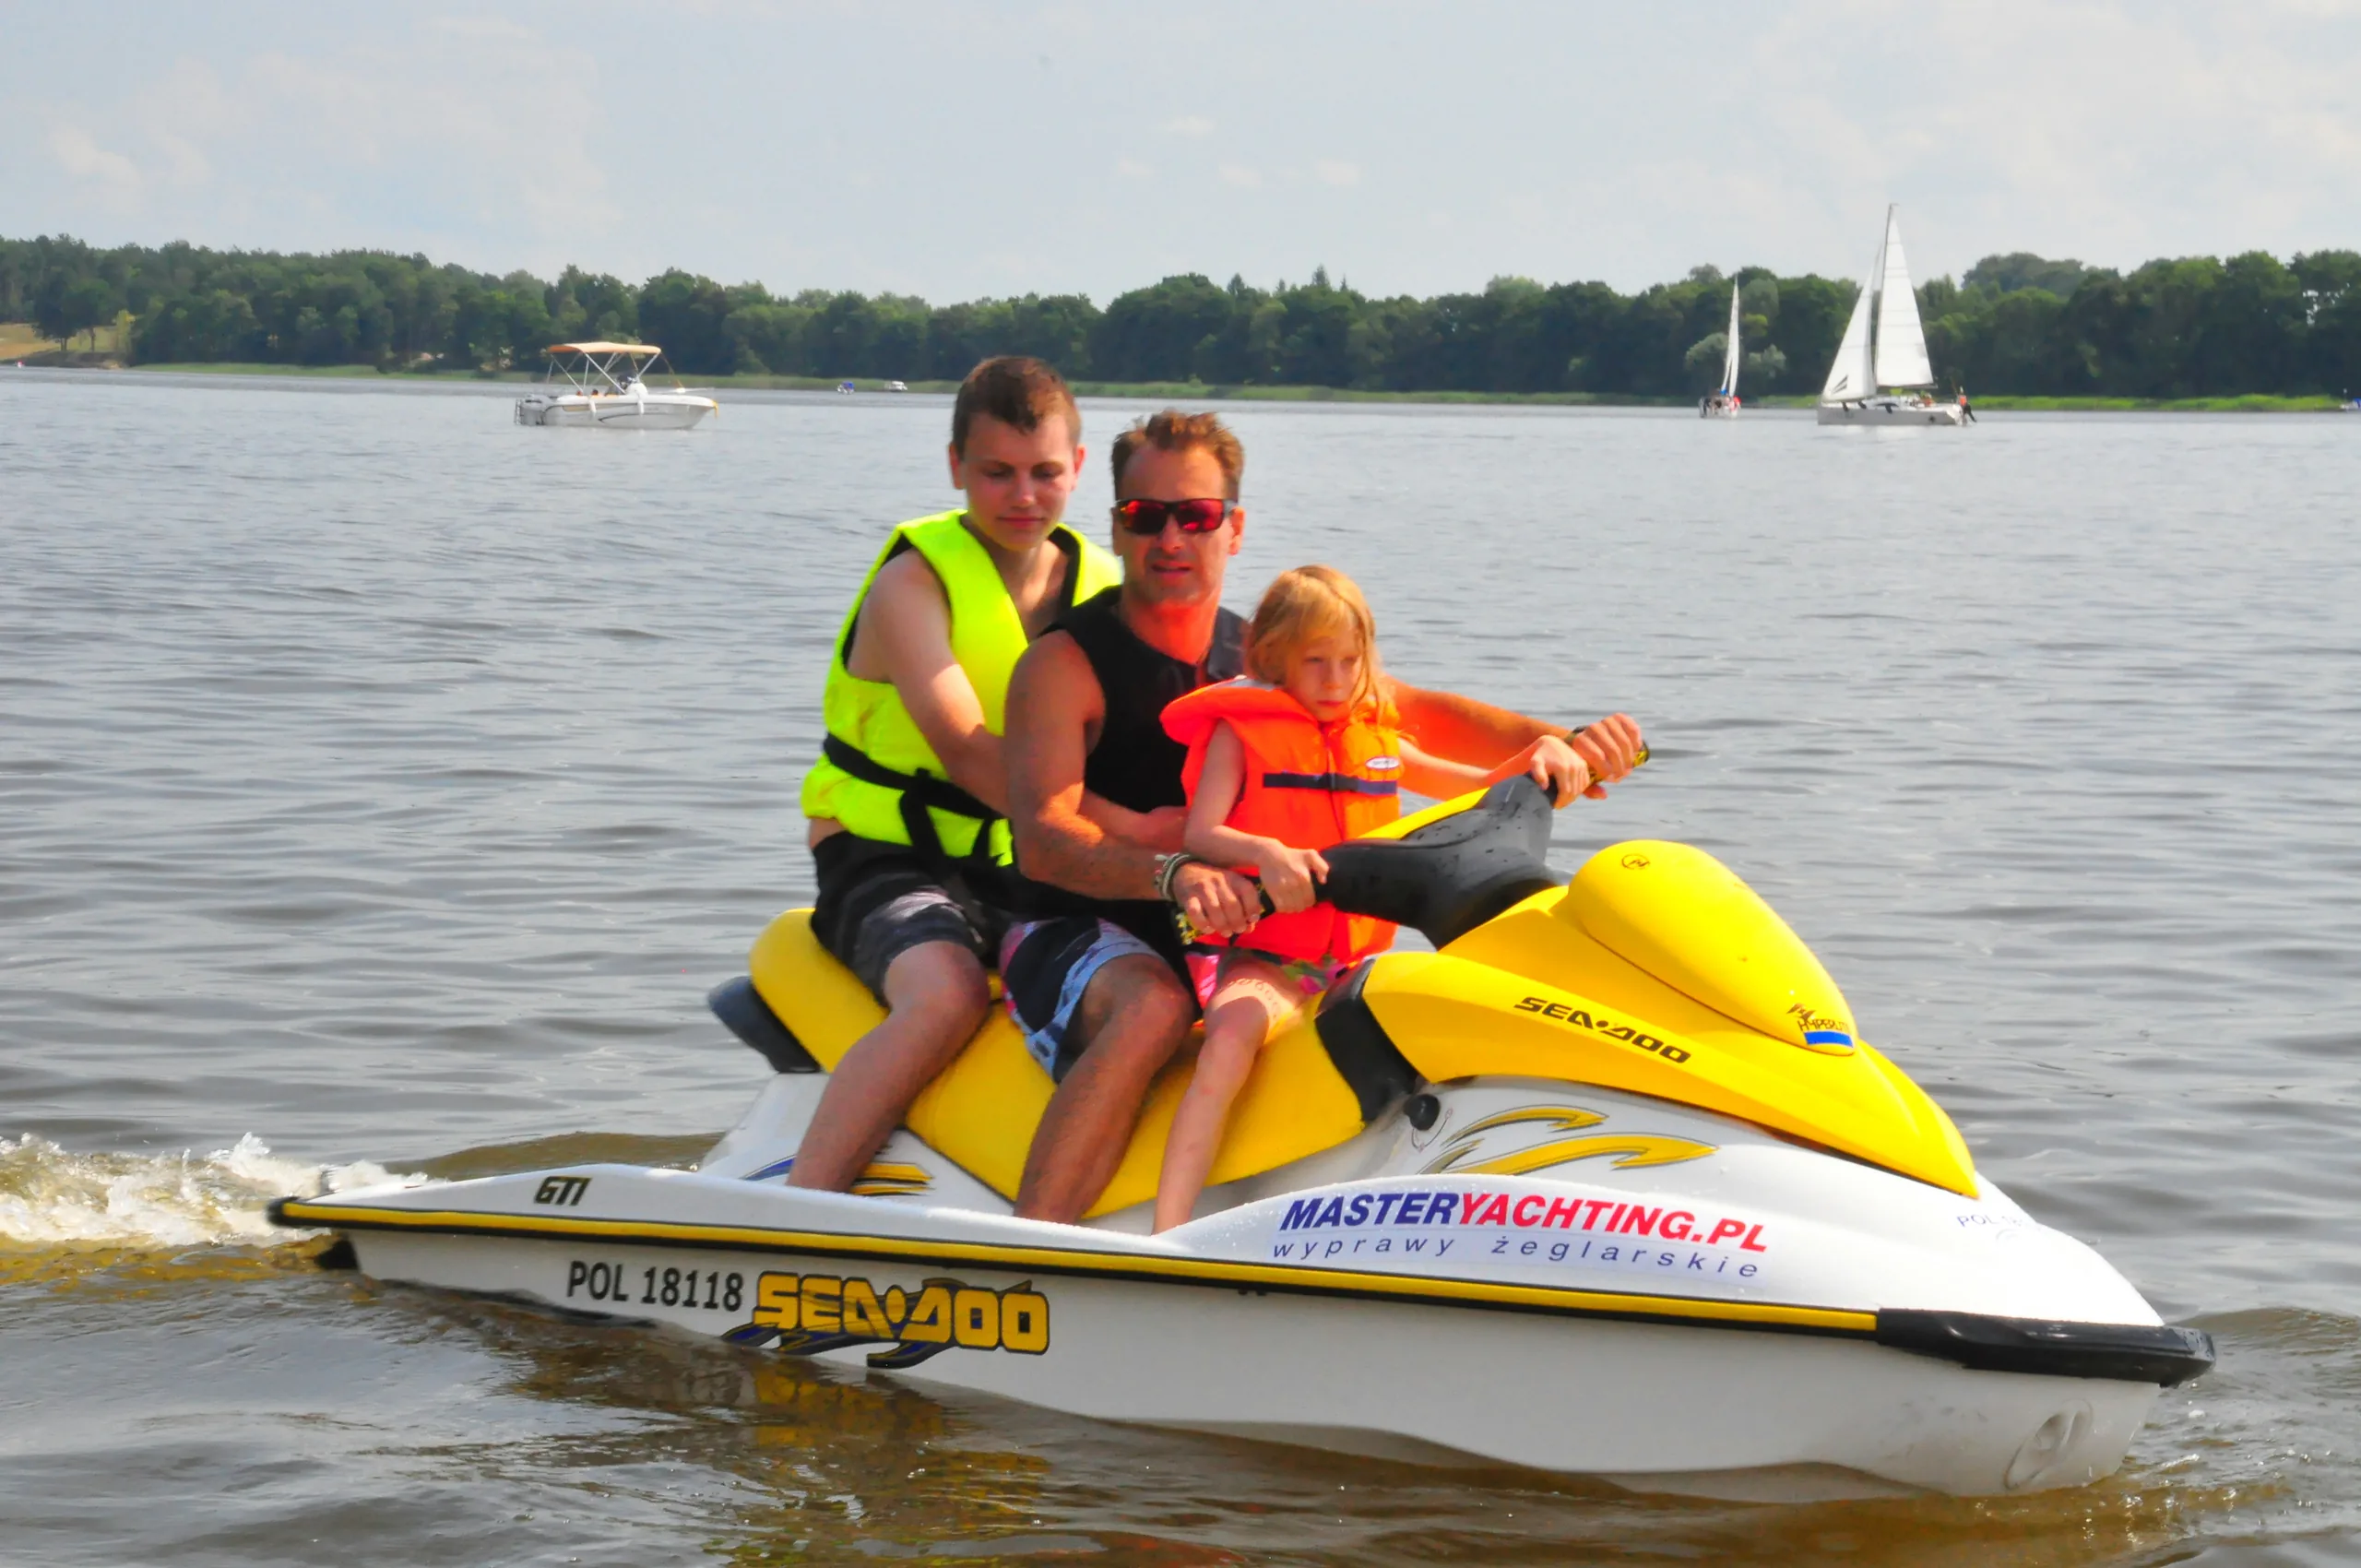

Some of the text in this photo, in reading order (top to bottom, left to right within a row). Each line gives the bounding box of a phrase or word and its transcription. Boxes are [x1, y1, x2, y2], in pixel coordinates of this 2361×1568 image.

[534, 1175, 592, 1206] GTI
[1279, 1192, 1767, 1253] MASTERYACHTING.PL
[1273, 1235, 1758, 1277] wyprawy żeglarskie
[566, 1260, 743, 1312] POL 18118
